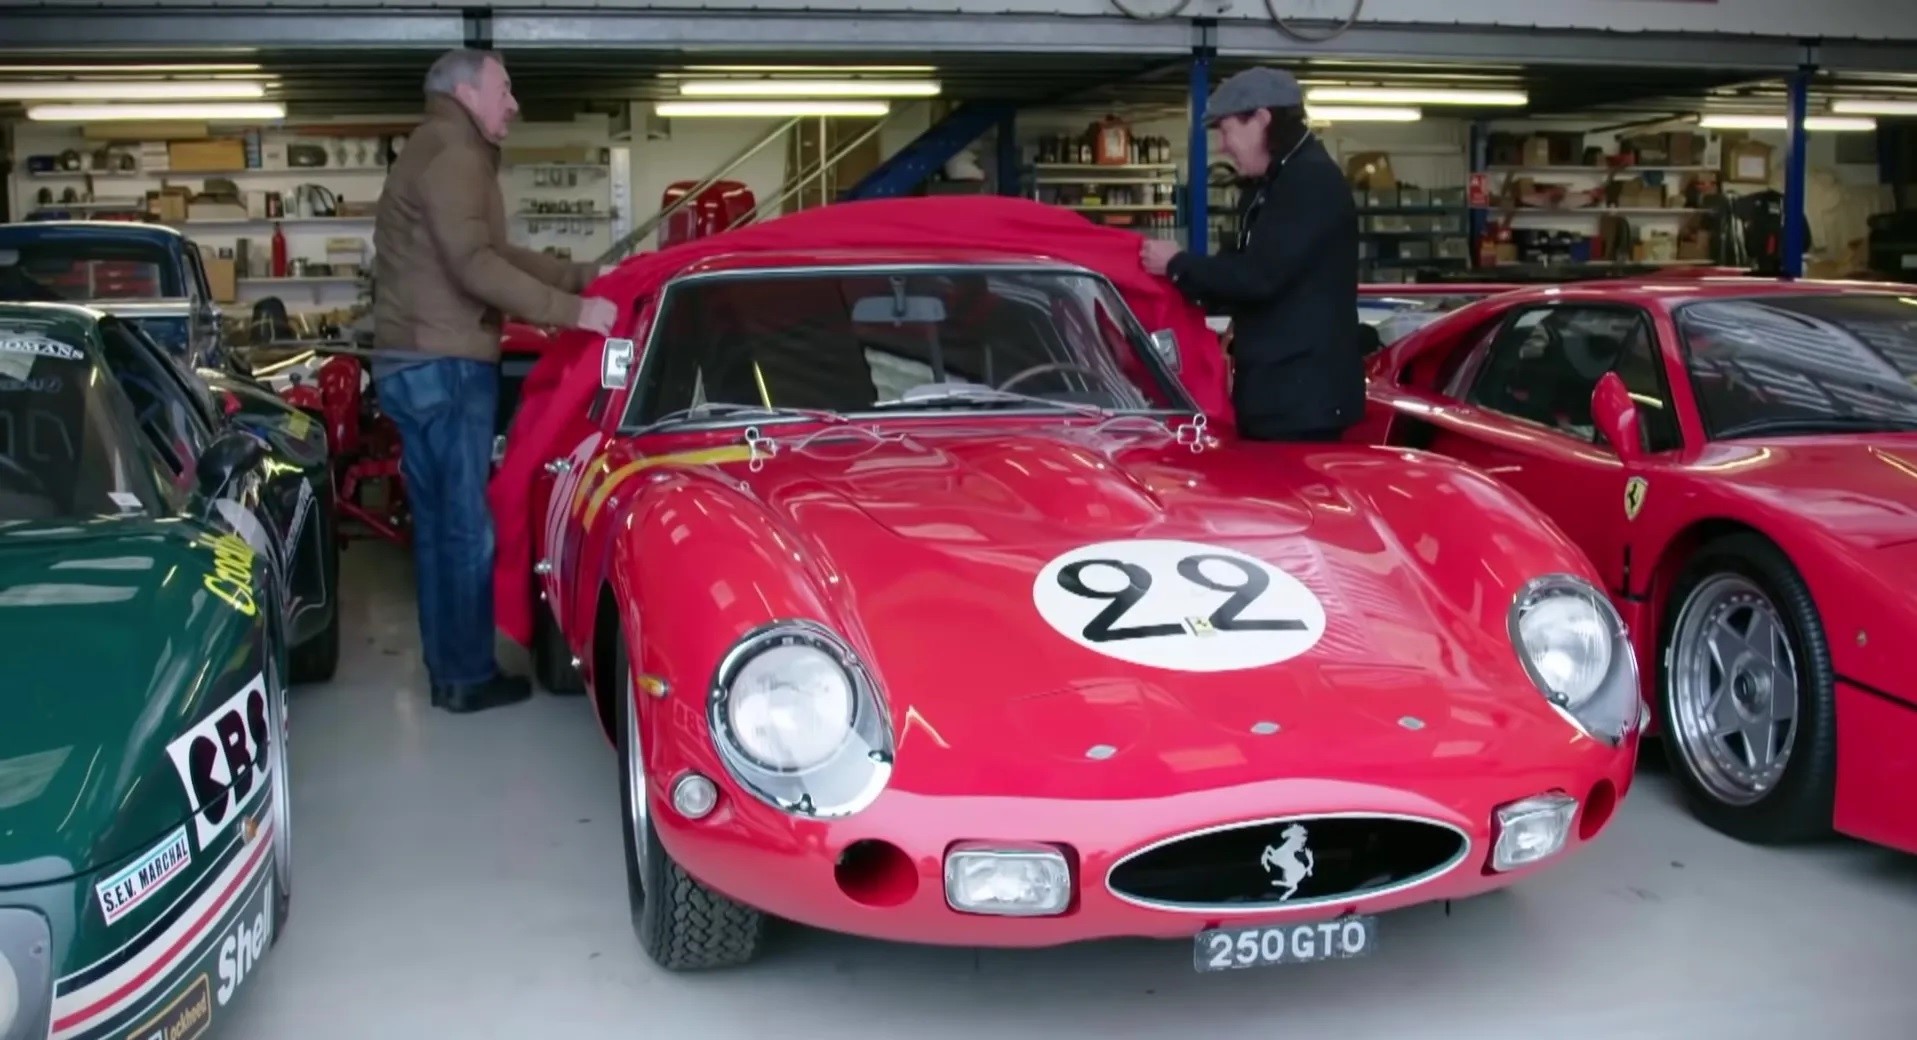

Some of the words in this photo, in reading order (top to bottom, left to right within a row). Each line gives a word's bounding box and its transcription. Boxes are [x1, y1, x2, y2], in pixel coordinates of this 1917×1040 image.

[1057, 553, 1308, 643] 22
[189, 689, 268, 825] CBS
[103, 878, 137, 912] S.E.V.
[138, 838, 187, 890] MARCHAL
[218, 876, 273, 1006] Shell
[1209, 929, 1285, 967] 250
[1291, 921, 1366, 958] GTO
